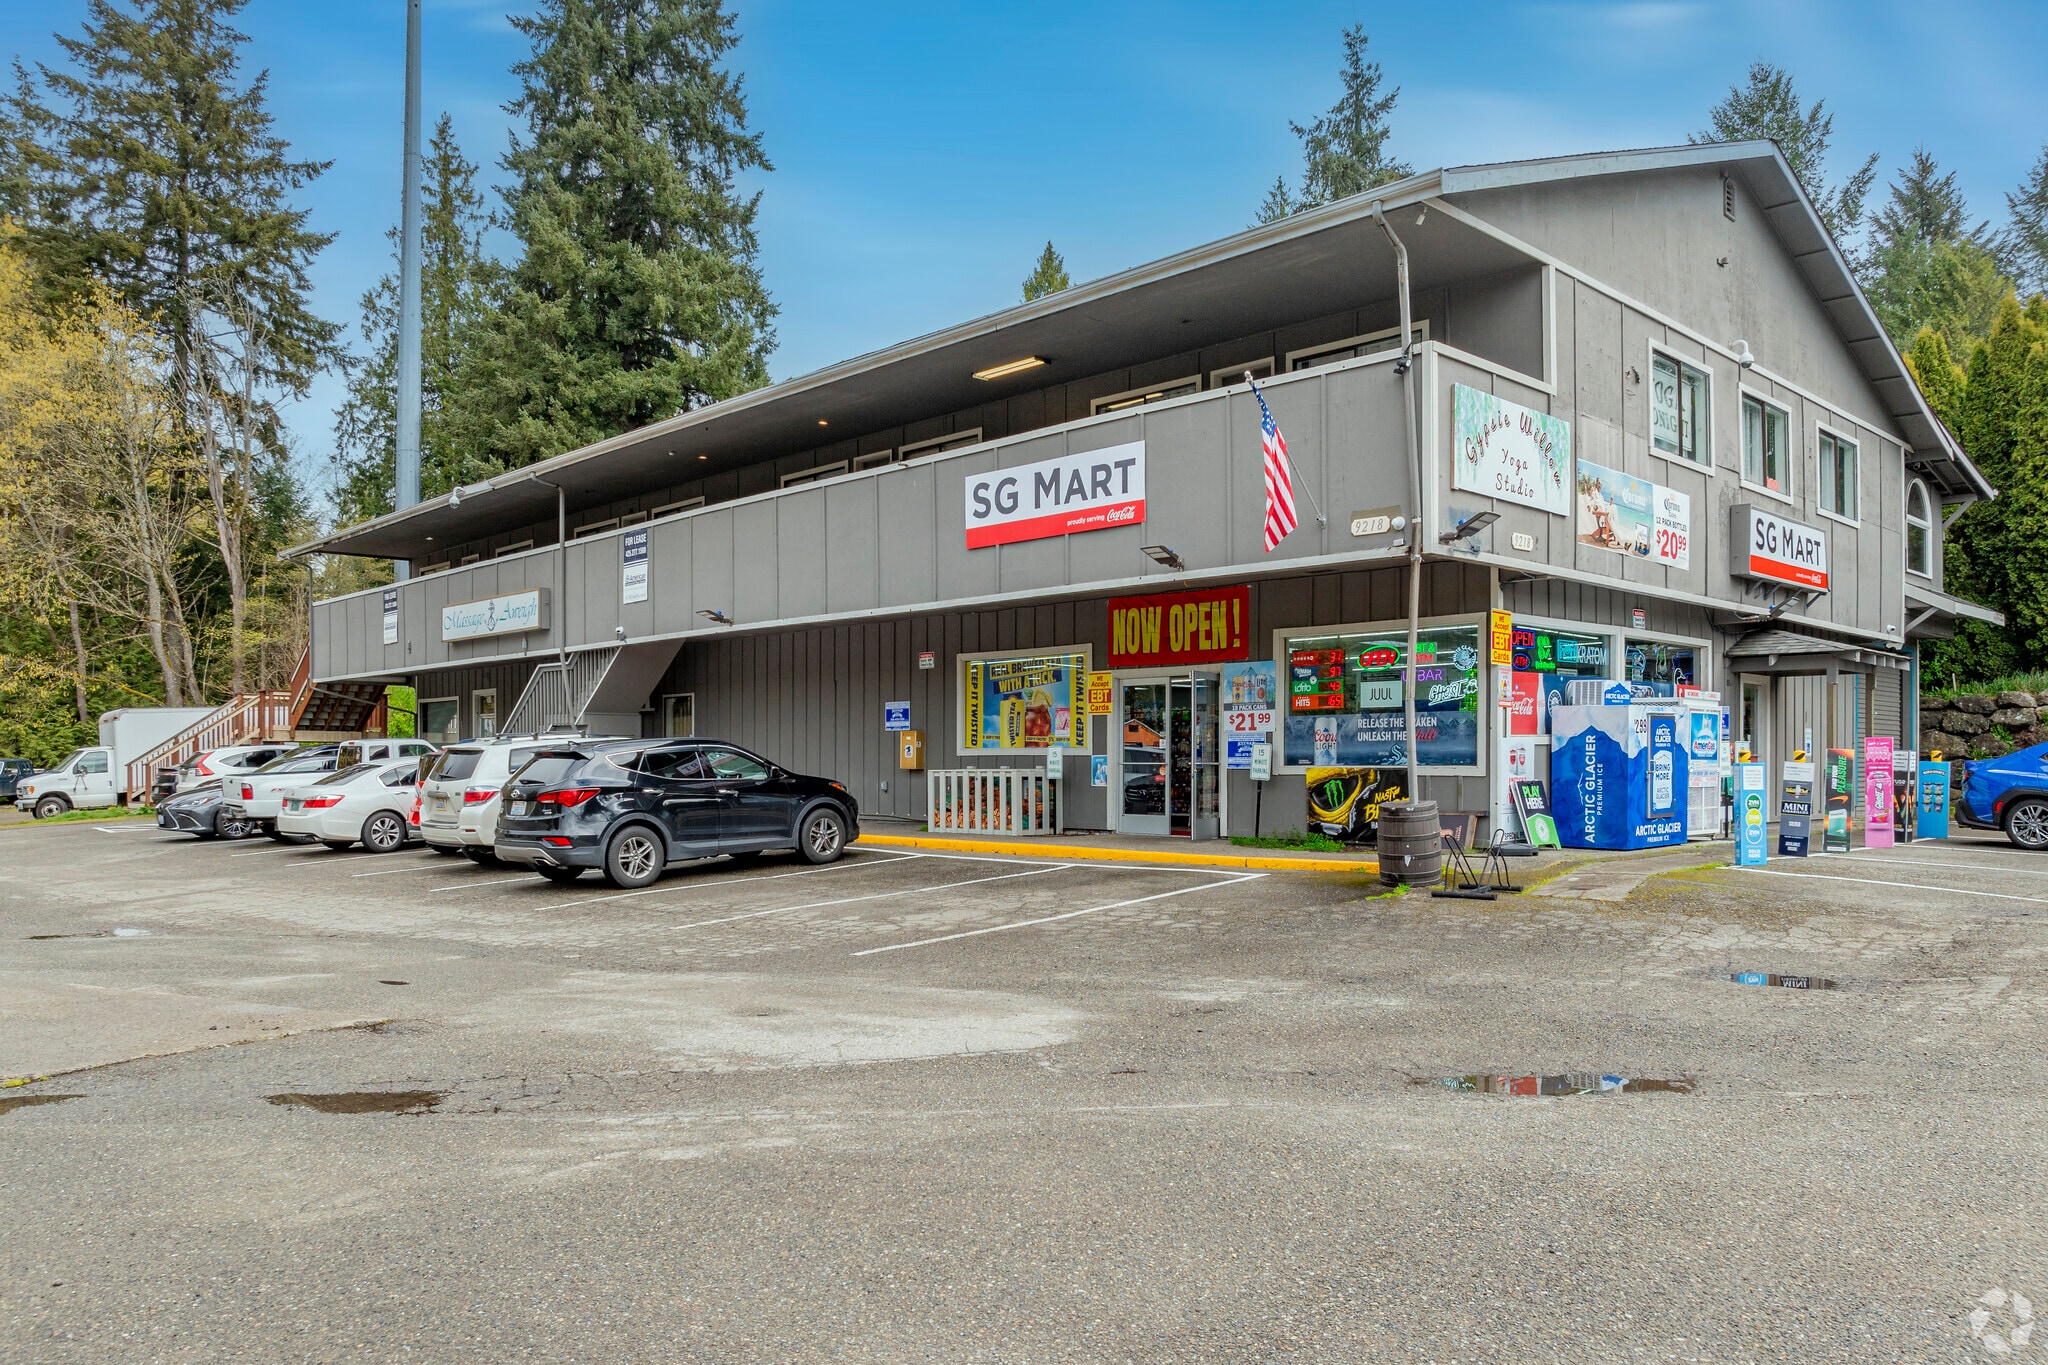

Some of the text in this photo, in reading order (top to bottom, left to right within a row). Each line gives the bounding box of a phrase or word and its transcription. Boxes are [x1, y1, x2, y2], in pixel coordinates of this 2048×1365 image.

[1465, 410, 1561, 489] Gypsie Willow
[973, 458, 1136, 519] SG MART
[1495, 473, 1534, 498] Studio
[1622, 487, 1646, 506] Corona
[1664, 497, 1680, 512] Corona
[1067, 517, 1086, 527] proudly
[1086, 514, 1105, 523] serving
[1355, 518, 1384, 533] 9218
[1662, 517, 1671, 527] PACK
[1672, 520, 1687, 532] BOTTLES
[625, 533, 647, 546] FOR LEASE
[1514, 535, 1531, 549] 9218
[1756, 518, 1821, 566] SG MART
[443, 610, 485, 633] Massage
[1494, 622, 1510, 631] Accept
[1113, 606, 1162, 655] NOW
[1512, 630, 1535, 646] OPEN
[1415, 643, 1427, 652] BT
[1493, 633, 1510, 650] EBT
[1330, 652, 1341, 663] 31
[1360, 649, 1397, 667] OPEN
[1493, 651, 1510, 661] Cards
[1515, 656, 1528, 666] ATM
[1577, 645, 1608, 666] KRATOM
[991, 664, 1010, 677] REAL
[1011, 658, 1045, 674] BREWED
[1329, 667, 1341, 677] 97
[998, 676, 1022, 693] WITH
[1024, 675, 1030, 688] A
[1329, 681, 1341, 691] 43
[1075, 656, 1085, 746] KEEP IT TWISTED
[1091, 690, 1109, 702] EBT
[1370, 688, 1393, 701] JUUL
[970, 664, 978, 746] KEEP IT TWISTED
[1357, 716, 1437, 728] RELEASE THE AKEN
[1008, 716, 1017, 747] TWISTED
[1357, 728, 1438, 742] UNLEASH THE hill
[1655, 735, 1671, 743] GLACIER
[1316, 742, 1336, 750] LIGHT
[1655, 763, 1670, 771] BRING
[1837, 755, 1847, 794] PLEASURE
[1374, 786, 1401, 803] NASTY
[1521, 785, 1540, 797] PLAY
[1584, 735, 1596, 843] ARCTIC GLACIER
[1525, 797, 1545, 809] HERE
[1784, 803, 1808, 811] MINI
[1635, 822, 1682, 837] ARCTIC GLACIER
